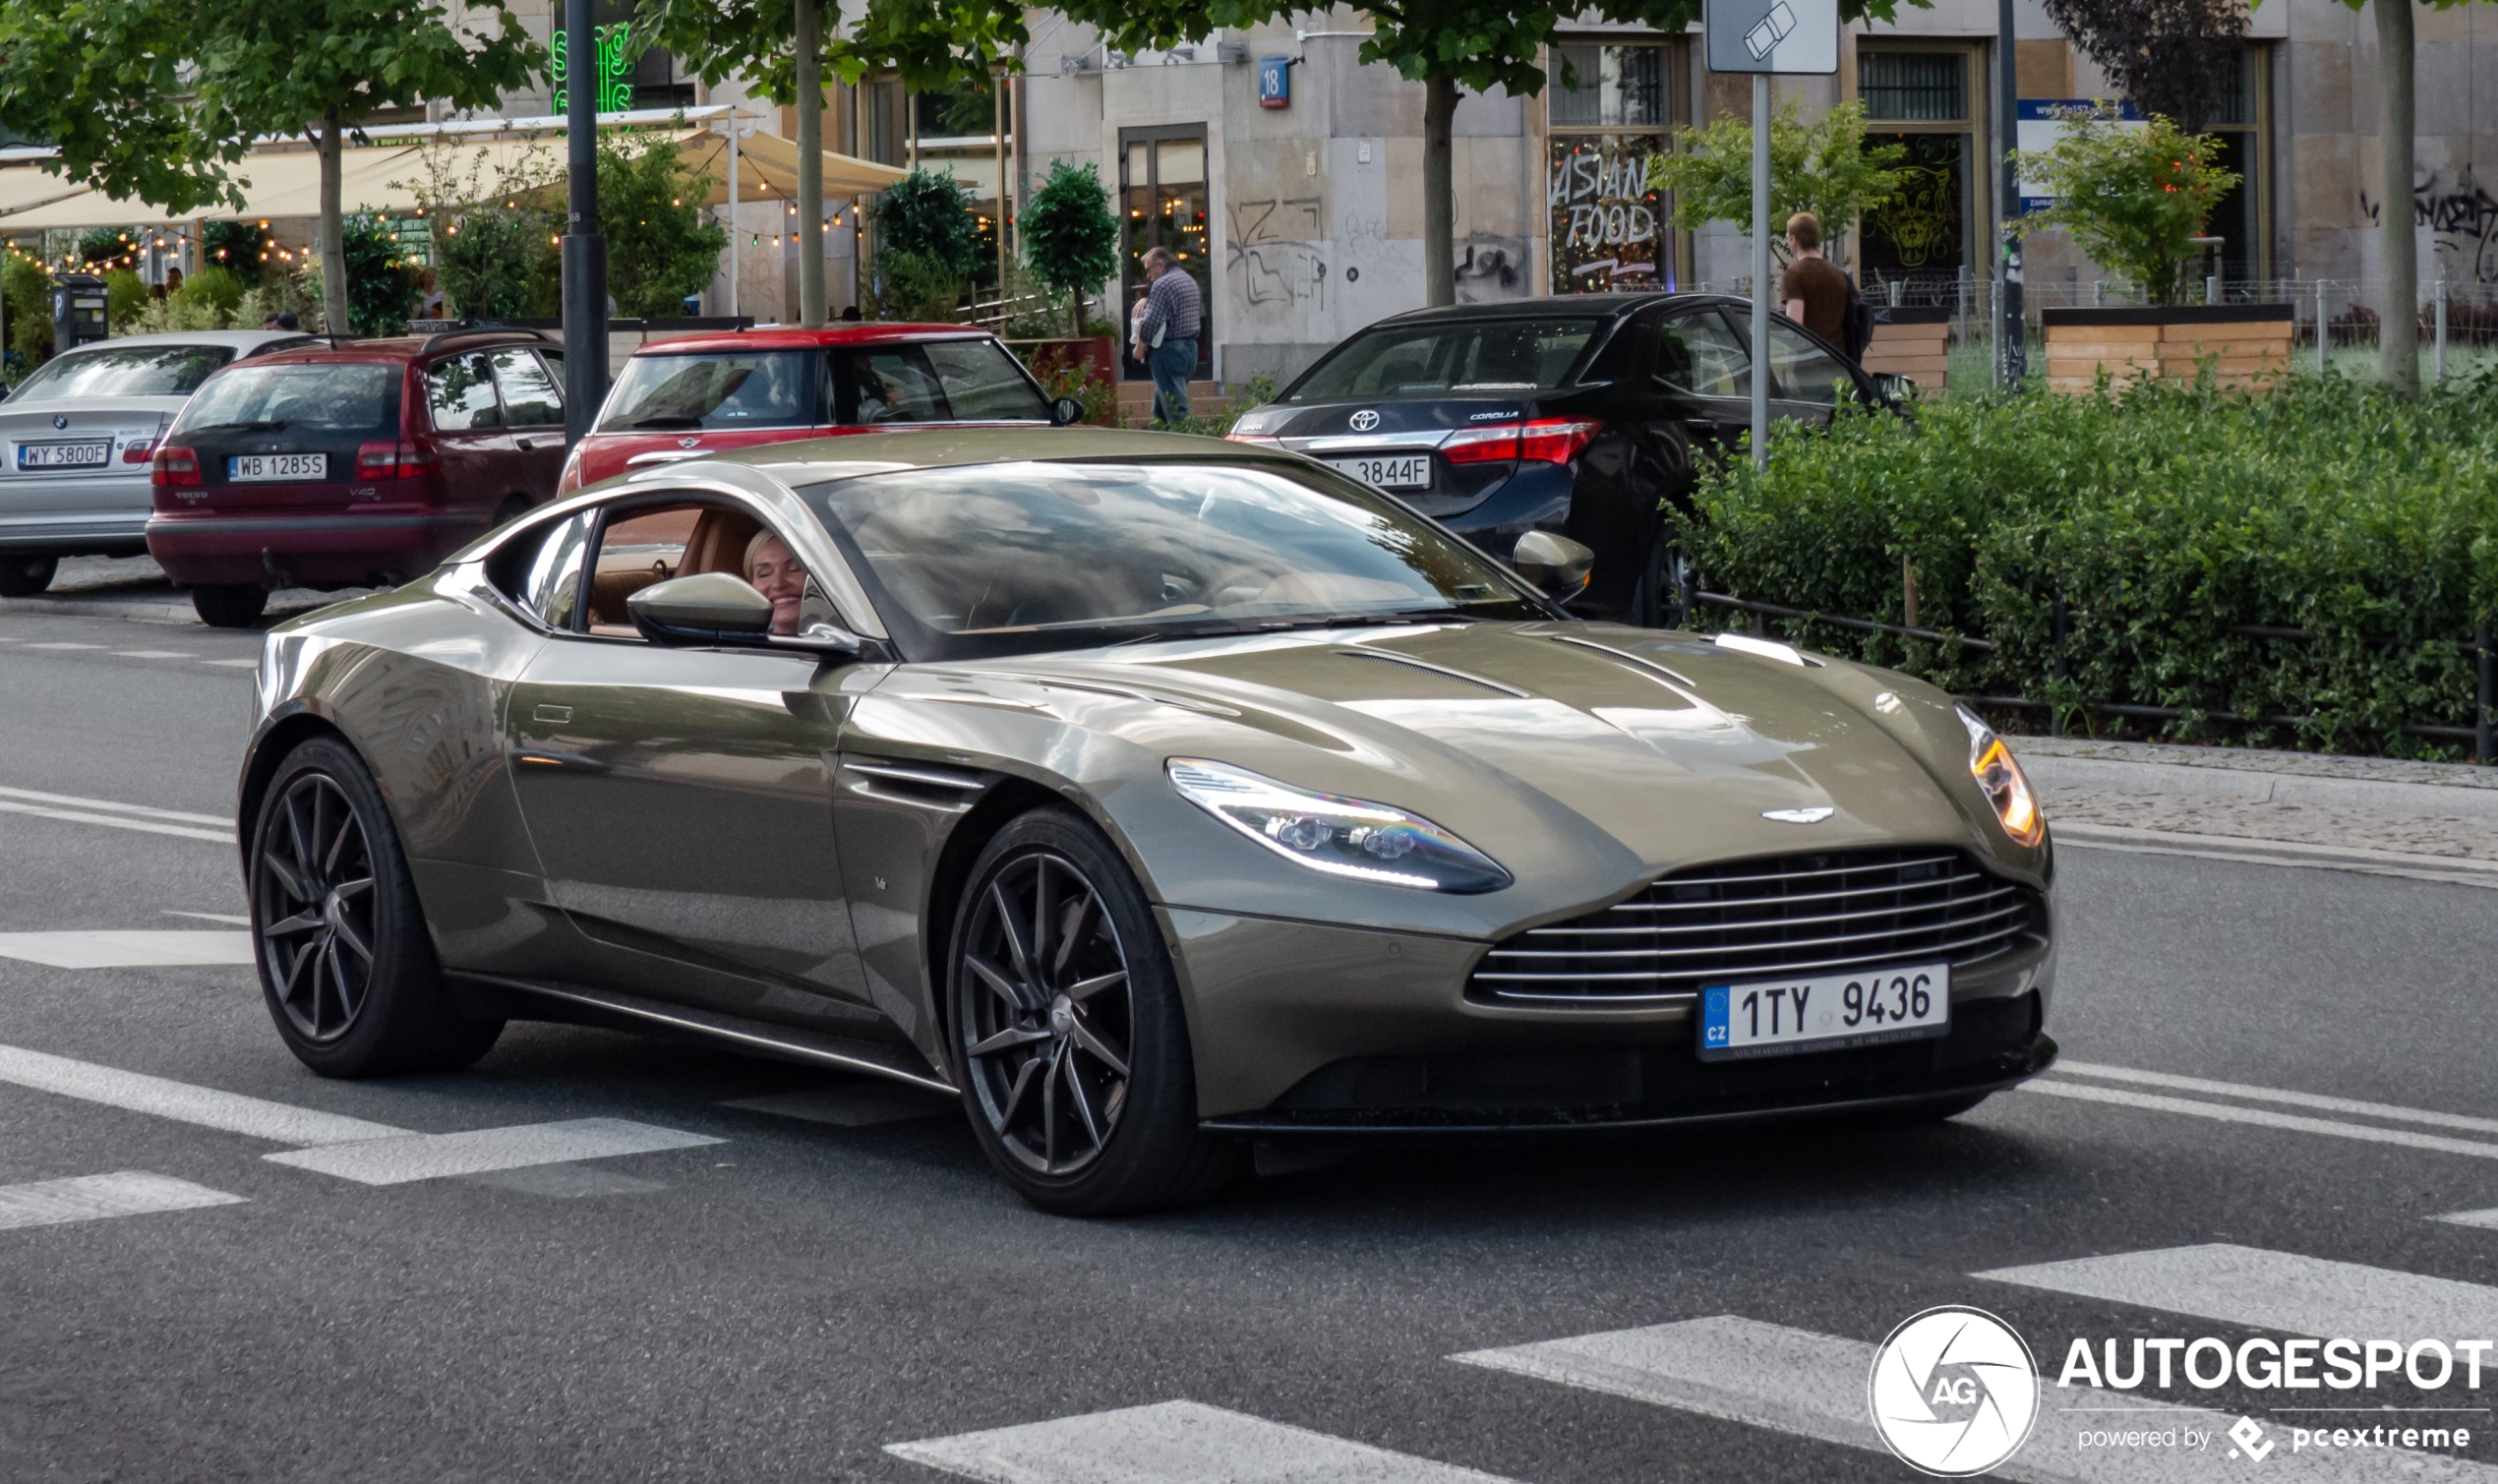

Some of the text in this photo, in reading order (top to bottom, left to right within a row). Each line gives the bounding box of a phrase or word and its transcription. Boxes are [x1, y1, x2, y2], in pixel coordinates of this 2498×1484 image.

[1264, 69, 1279, 95] 18
[1550, 153, 1650, 207] ASIAN
[1566, 203, 1654, 249] FOOD
[1469, 410, 1519, 421] COROLLA
[29, 445, 104, 464] WY 5800F
[241, 455, 323, 476] WB 1285S
[349, 488, 376, 497] V40
[1742, 974, 1931, 1038] 1TY 9436
[1707, 1026, 1726, 1041] CZ
